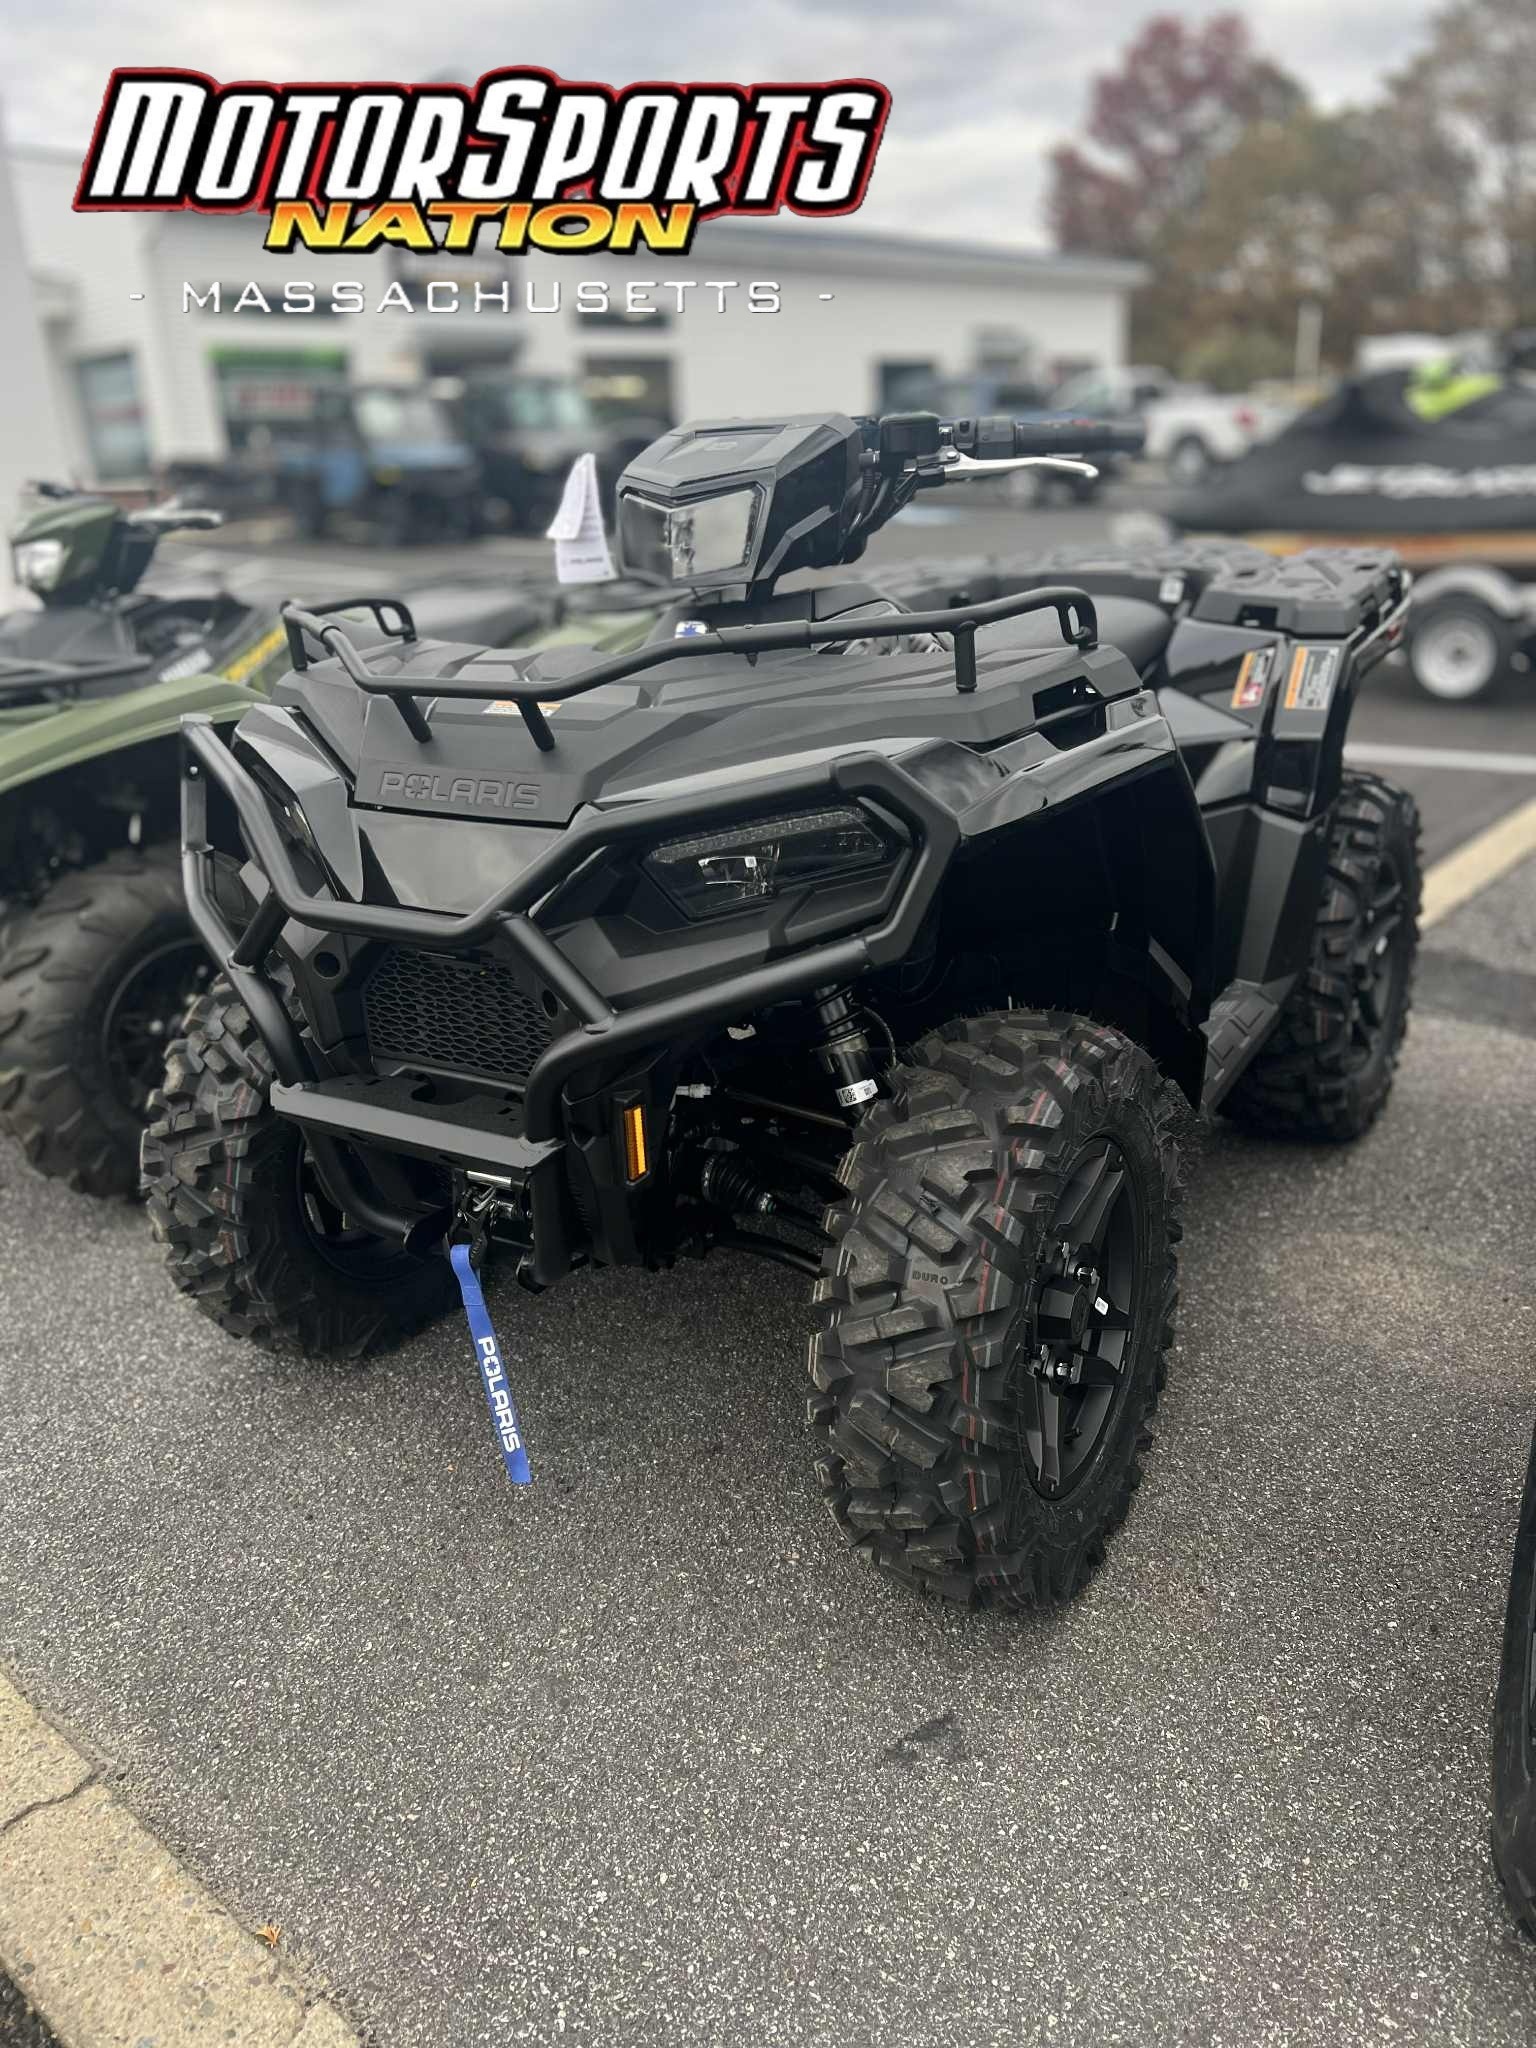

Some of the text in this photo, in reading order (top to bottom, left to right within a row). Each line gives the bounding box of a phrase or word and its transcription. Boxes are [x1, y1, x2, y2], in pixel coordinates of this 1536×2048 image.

[380, 771, 542, 809] POLARIS
[912, 1271, 948, 1285] DURO
[478, 1336, 521, 1453] POLARIS
